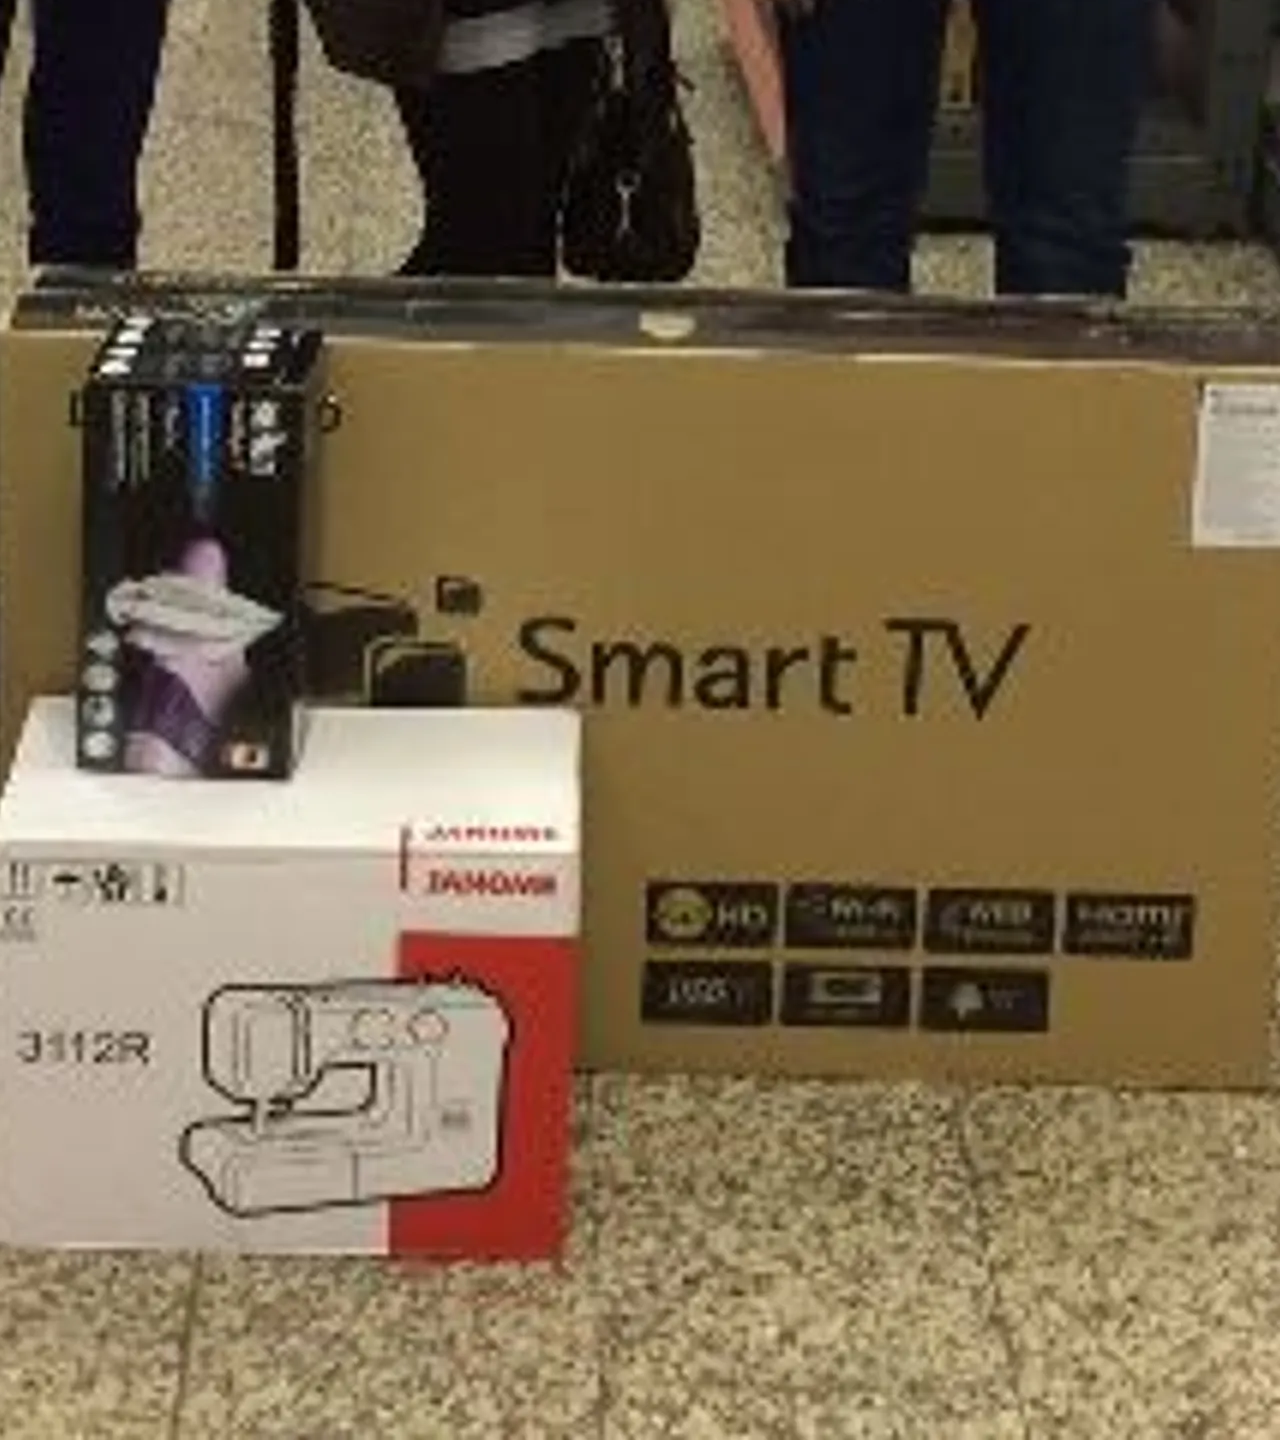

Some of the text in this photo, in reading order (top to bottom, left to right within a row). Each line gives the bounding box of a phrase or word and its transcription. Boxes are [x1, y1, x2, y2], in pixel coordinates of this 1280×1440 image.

[517, 617, 1030, 720] Smart TV
[17, 1031, 150, 1065] 3112R
